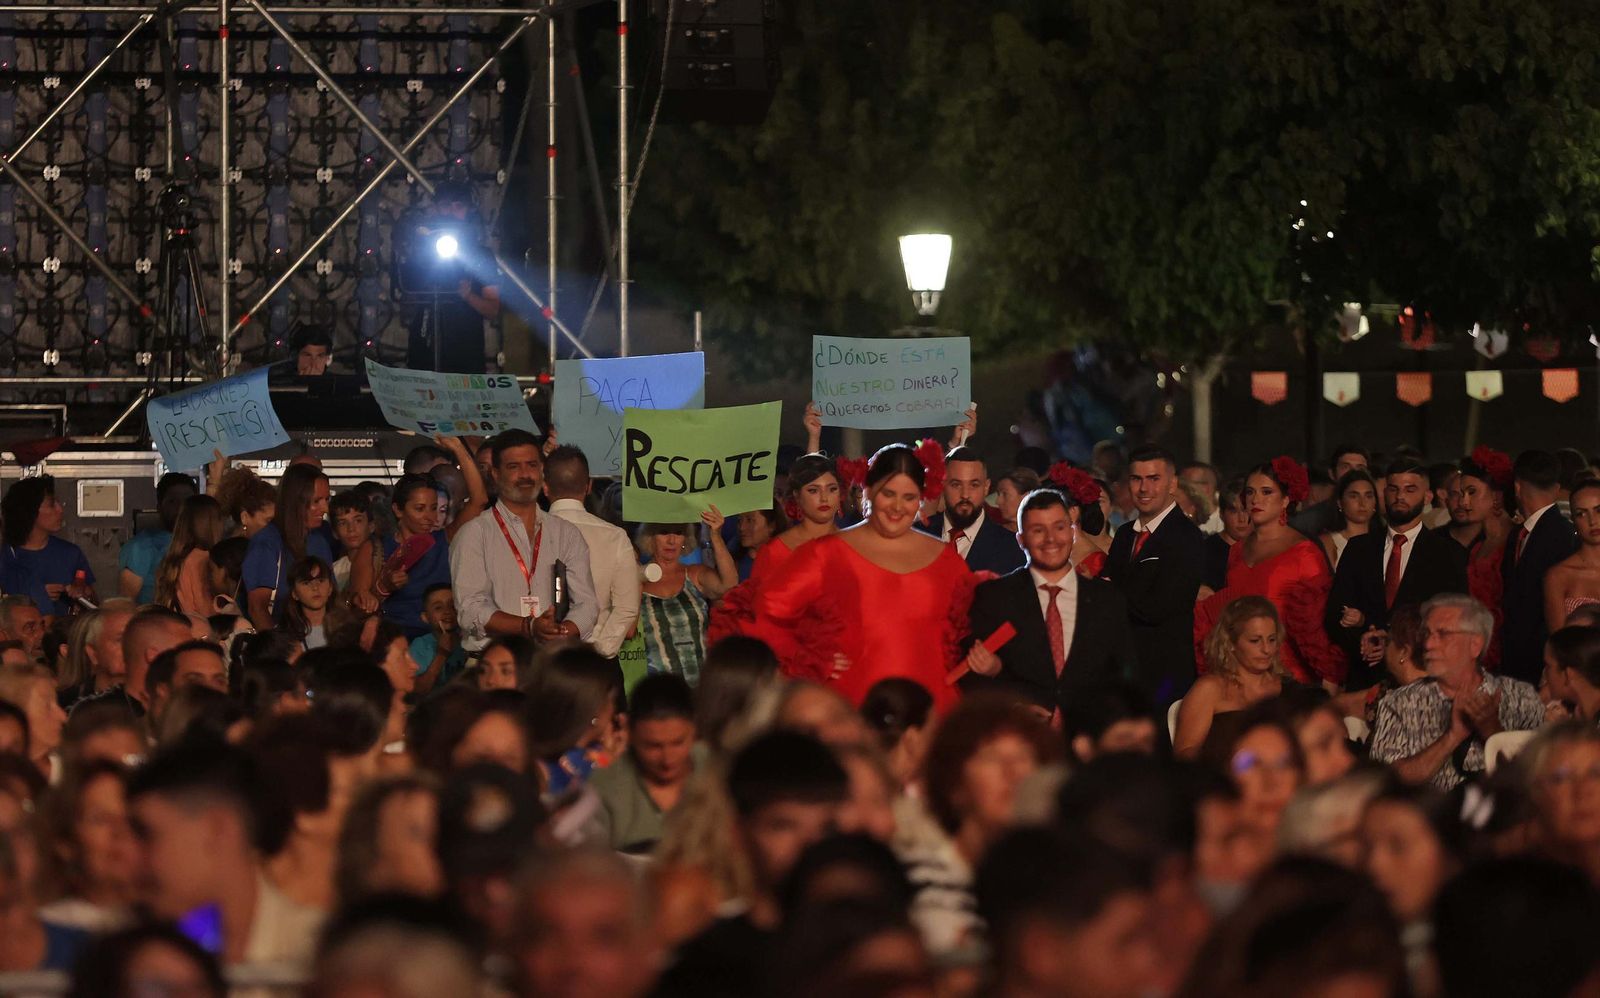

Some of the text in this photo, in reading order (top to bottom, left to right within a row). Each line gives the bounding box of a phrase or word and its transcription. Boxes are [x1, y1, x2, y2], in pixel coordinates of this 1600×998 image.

[815, 340, 889, 368] ¿DÓNDE
[578, 376, 656, 416] PAGA
[815, 367, 959, 397] NUESTRO DINERO?
[818, 396, 960, 417] ¡QUEREMOS COBRAR!
[625, 428, 771, 494] RESCATE
